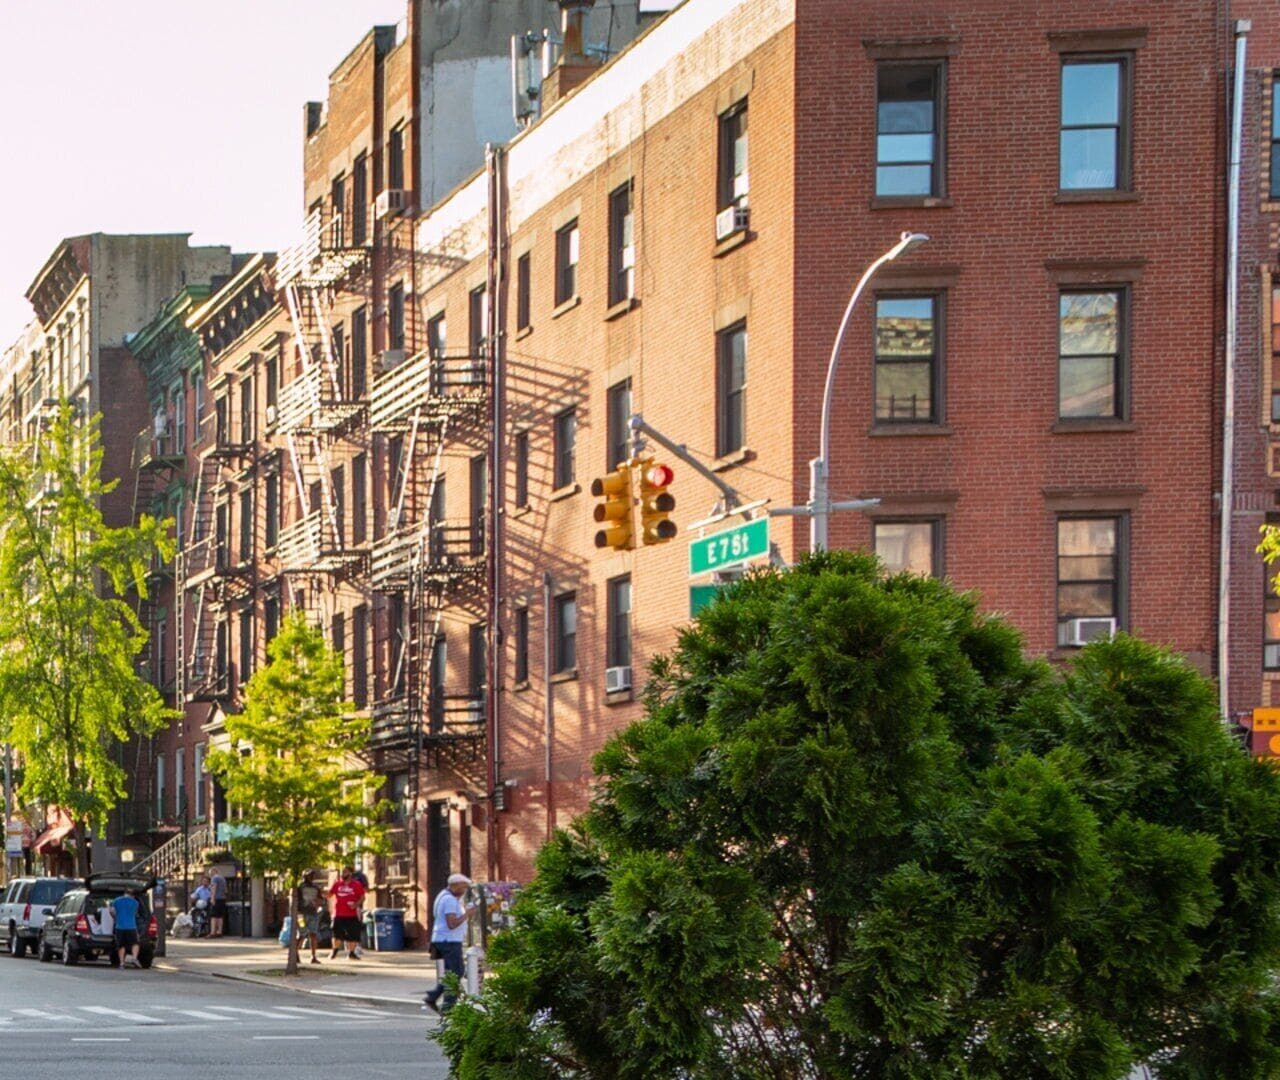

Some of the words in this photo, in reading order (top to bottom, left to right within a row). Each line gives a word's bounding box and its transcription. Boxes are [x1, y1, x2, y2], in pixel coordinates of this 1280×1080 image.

[707, 541, 717, 564] E
[719, 538, 729, 560] 7
[732, 532, 749, 556] St
